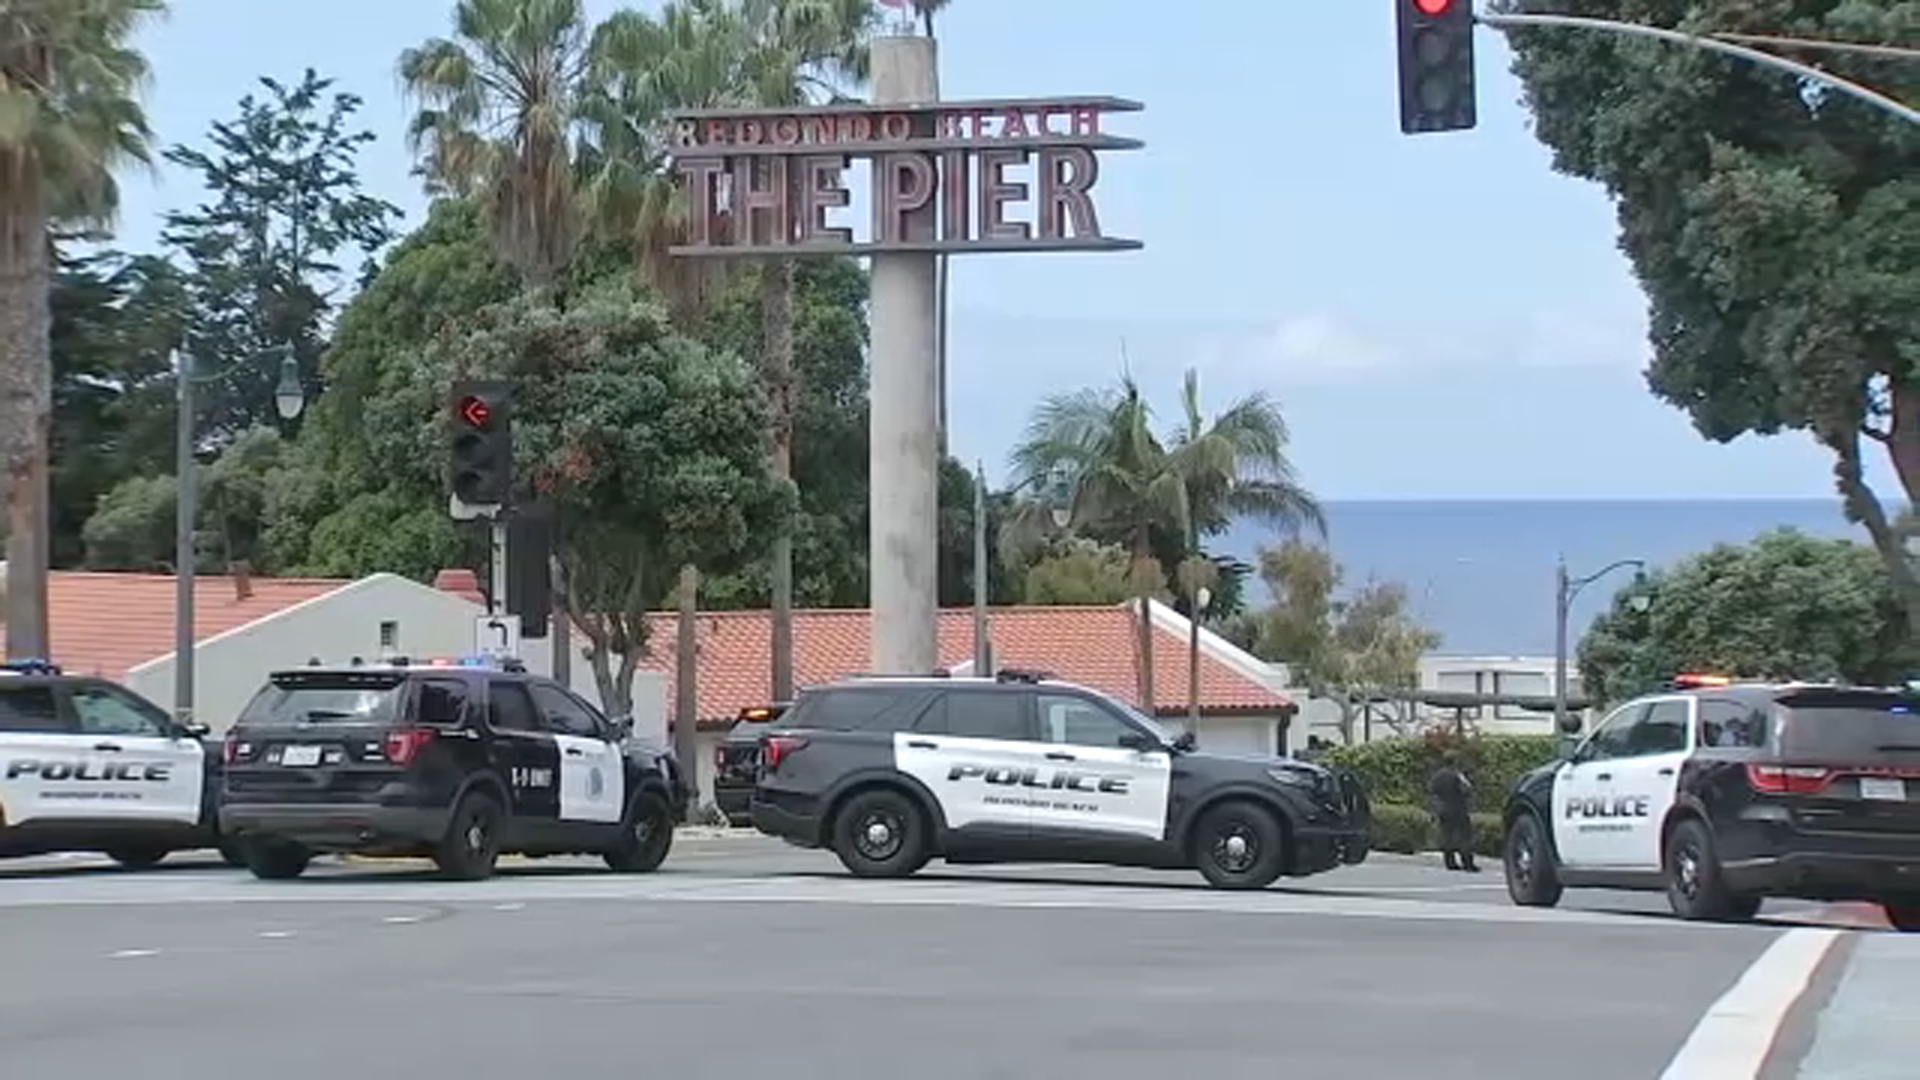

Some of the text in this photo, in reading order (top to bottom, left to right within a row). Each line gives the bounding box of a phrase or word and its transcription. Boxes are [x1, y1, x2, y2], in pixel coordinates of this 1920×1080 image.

[675, 106, 1101, 149] REDONDO BEACH
[677, 145, 1101, 247] THE PIER
[6, 759, 174, 781] POLICE
[946, 765, 1133, 795] POLICE
[1565, 794, 1651, 819] POLICE
